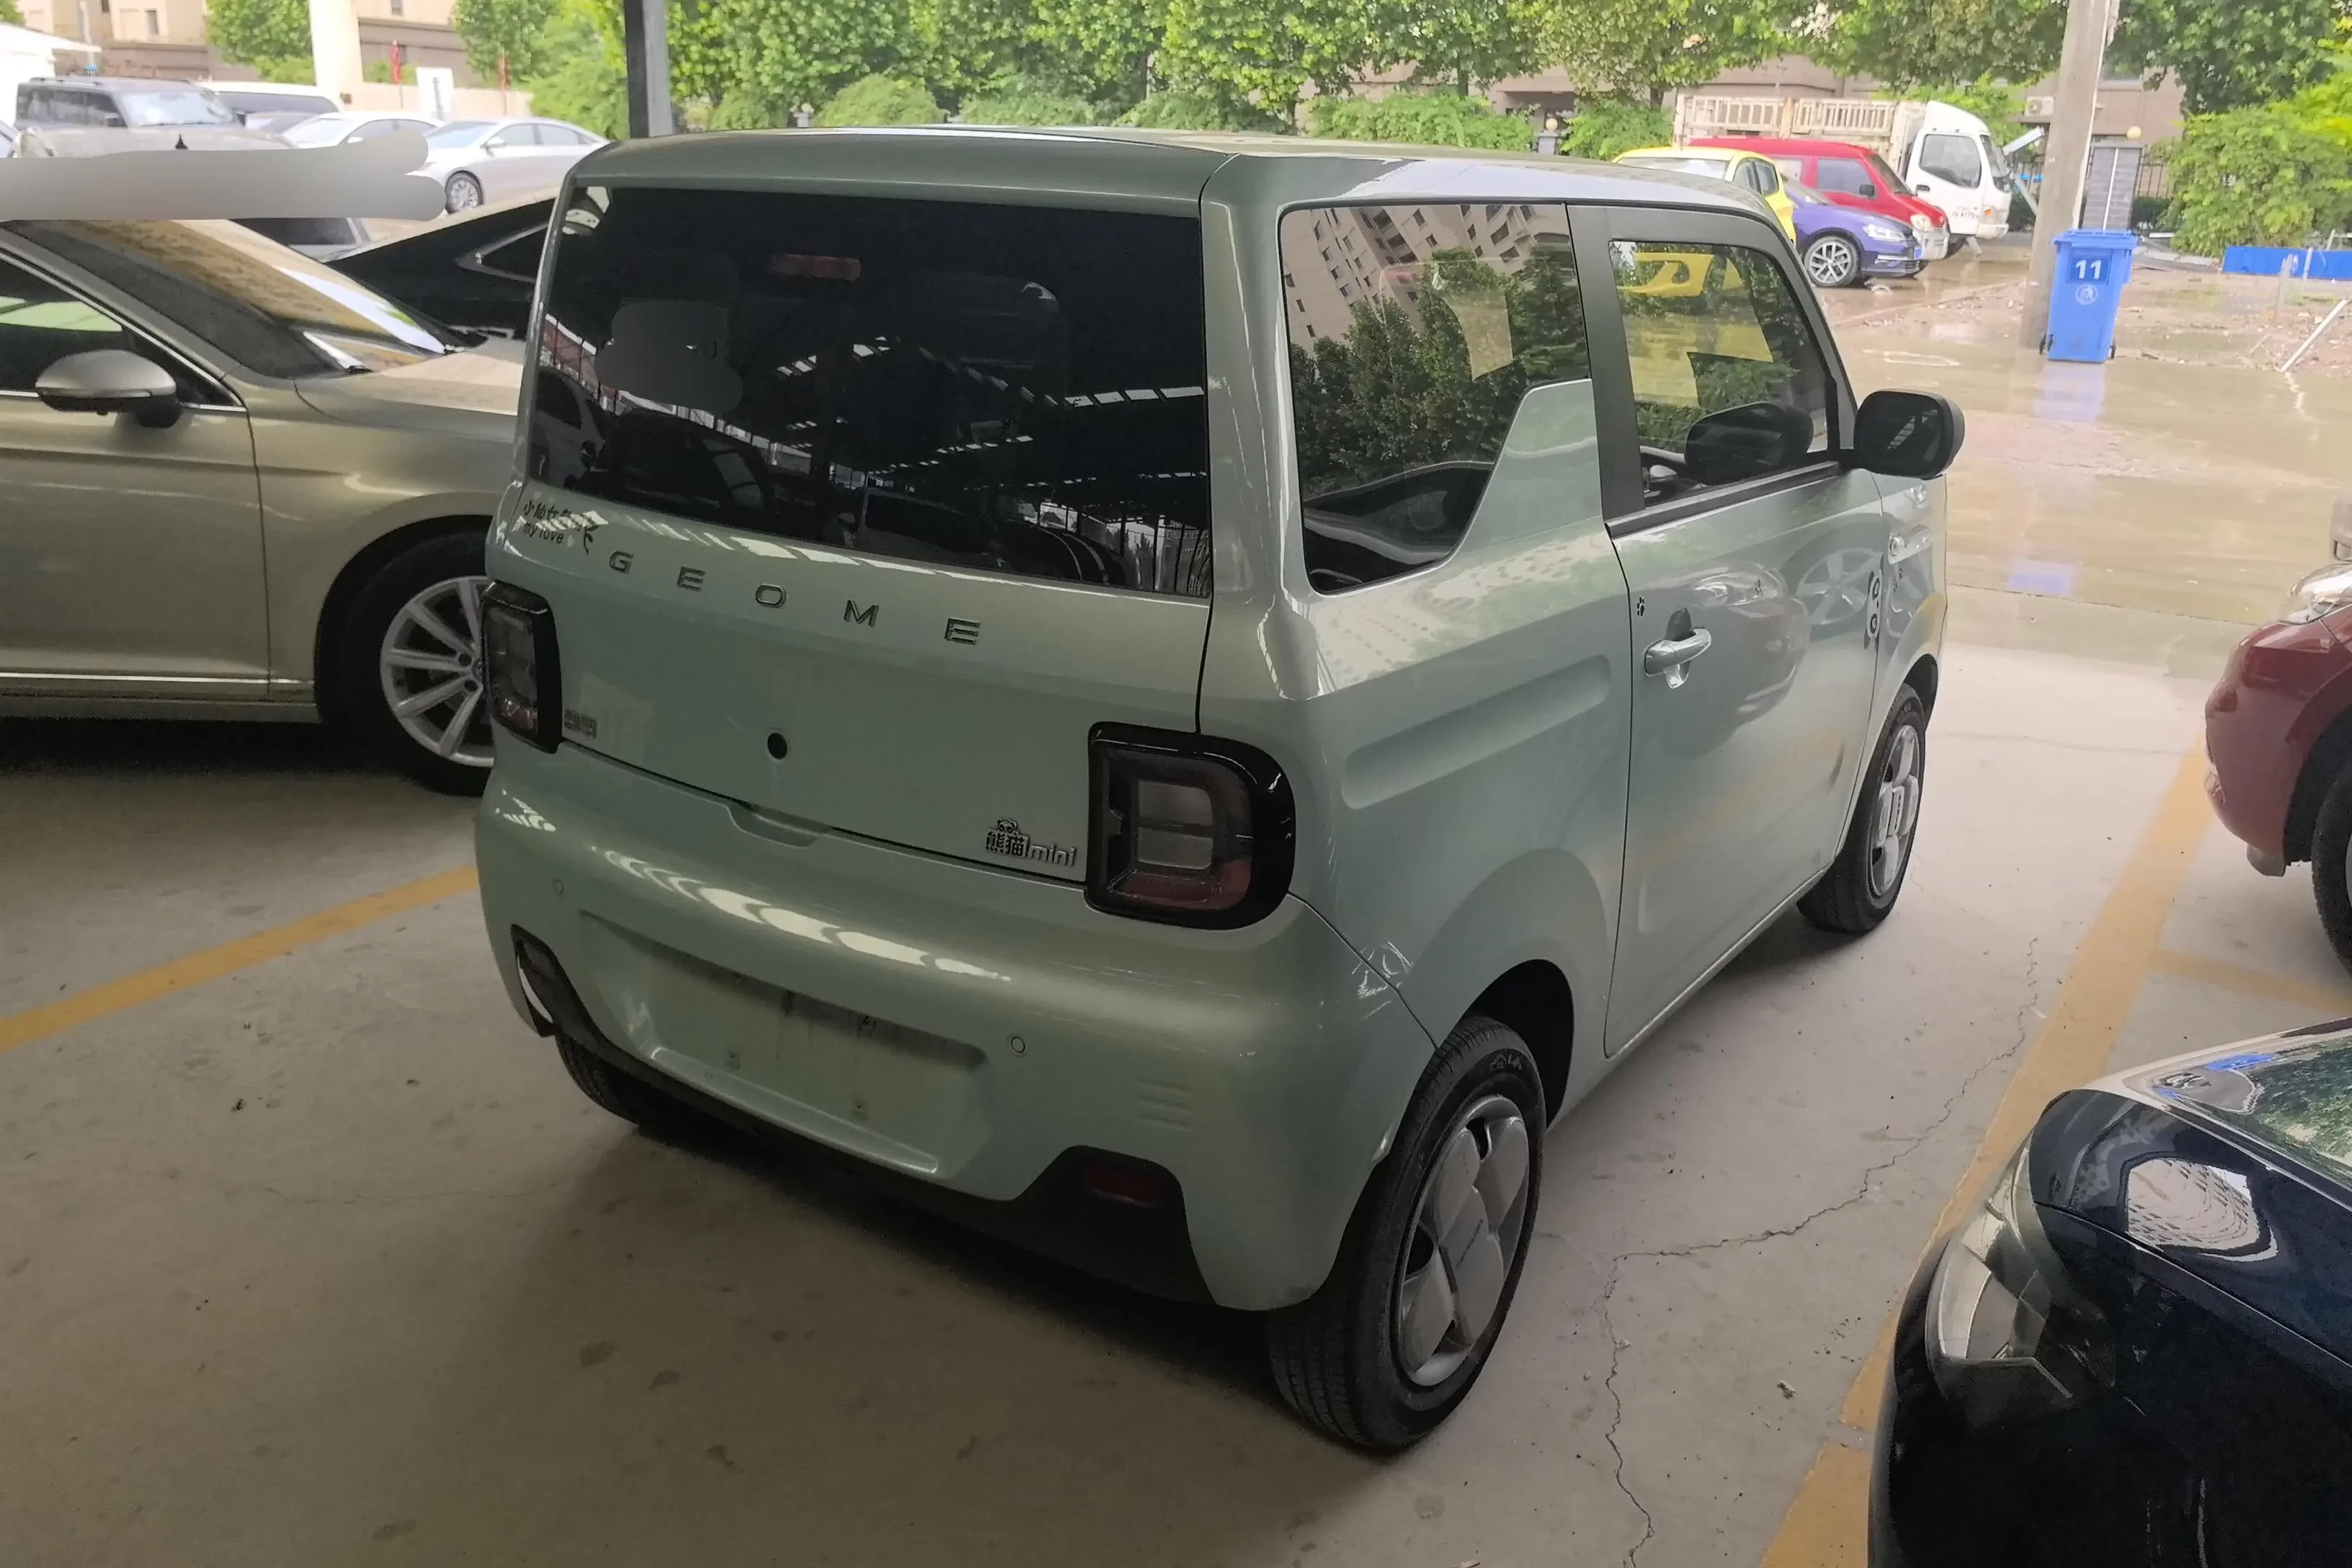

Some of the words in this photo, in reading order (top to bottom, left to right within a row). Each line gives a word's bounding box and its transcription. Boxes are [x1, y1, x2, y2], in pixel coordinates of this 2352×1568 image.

[2076, 259, 2102, 280] 11
[539, 527, 565, 544] love
[609, 549, 981, 646] GEOME
